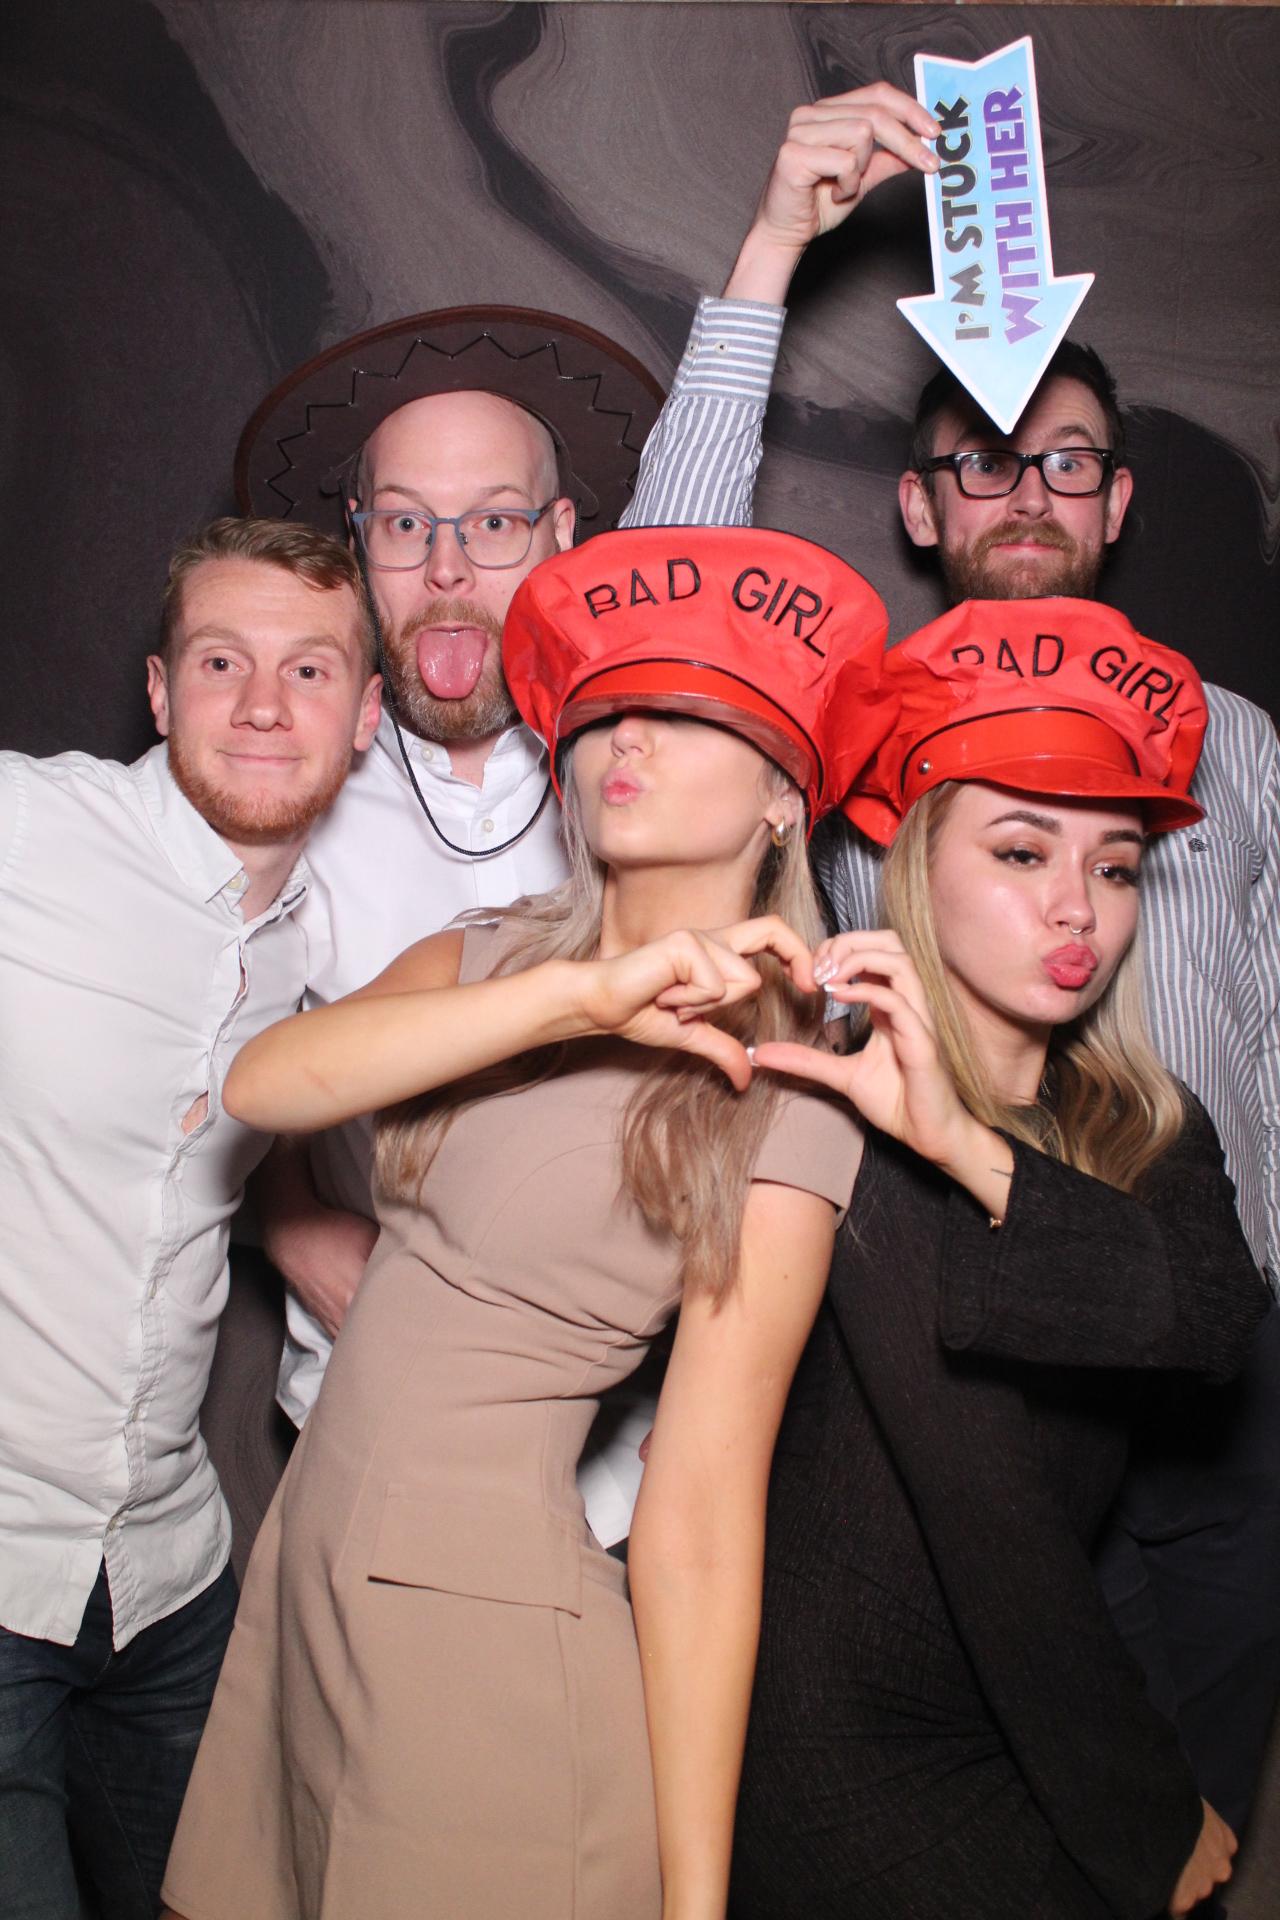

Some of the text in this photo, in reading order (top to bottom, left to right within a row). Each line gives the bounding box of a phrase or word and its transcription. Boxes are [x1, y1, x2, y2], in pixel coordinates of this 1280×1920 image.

[934, 95, 992, 341] I'M STUCK
[982, 84, 1047, 345] WITH HER
[584, 558, 834, 658] BAD GIRL
[1090, 645, 1185, 730] GIRL
